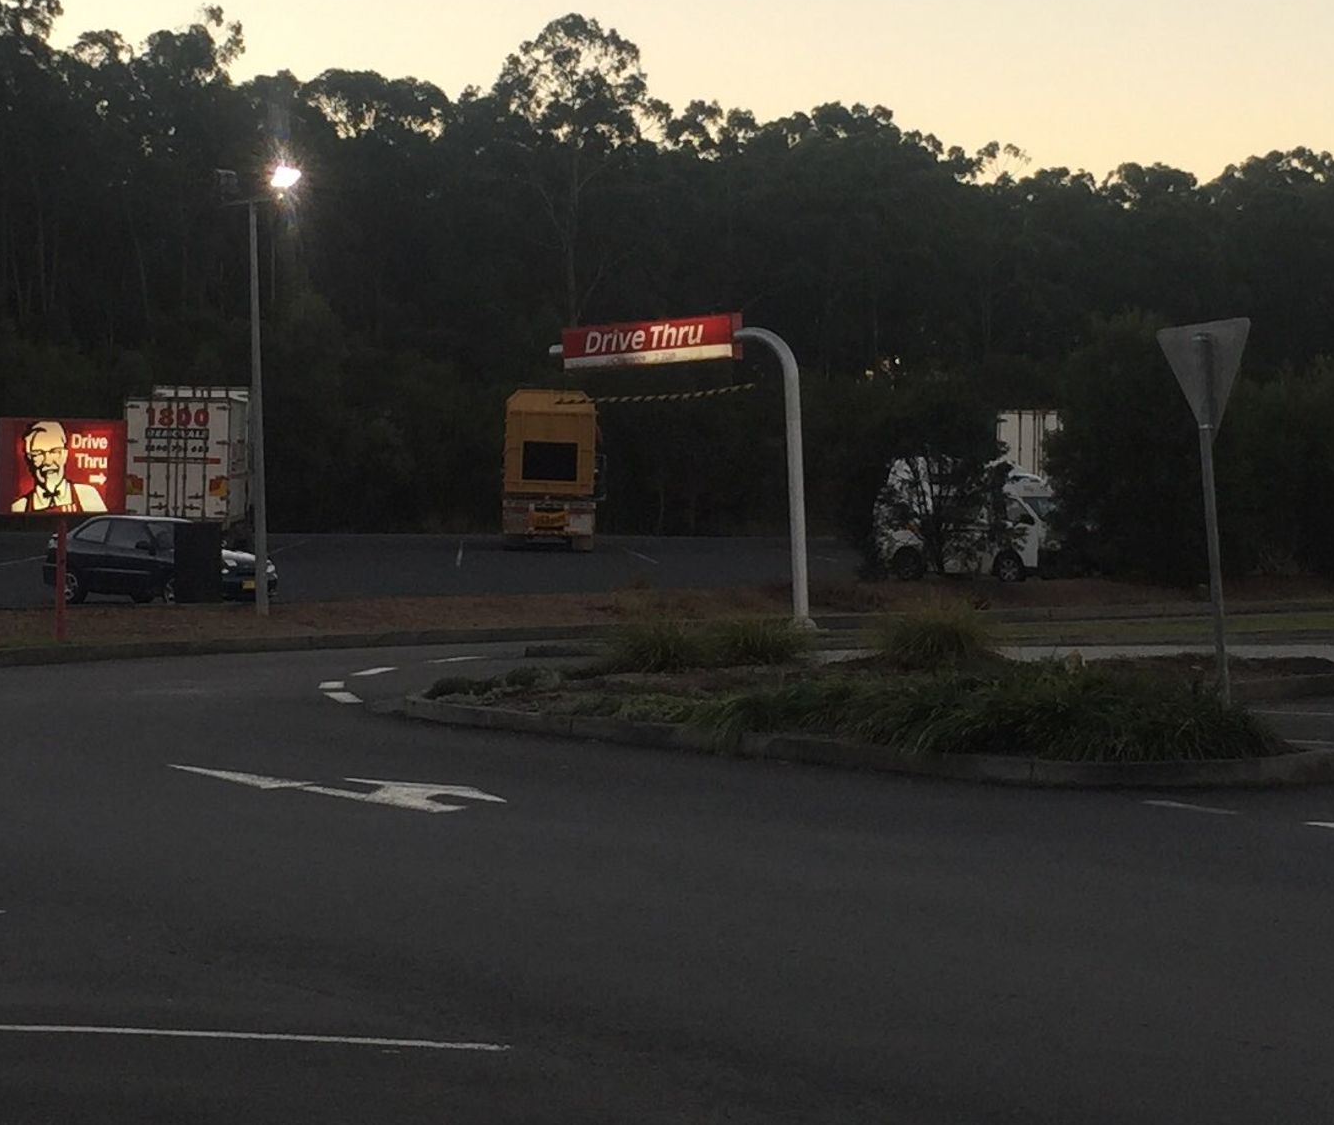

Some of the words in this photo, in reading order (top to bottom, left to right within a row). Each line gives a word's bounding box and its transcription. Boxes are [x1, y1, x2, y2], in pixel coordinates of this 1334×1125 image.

[585, 329, 646, 354] Drive
[649, 324, 704, 349] Thru
[146, 408, 209, 426] 1800
[71, 434, 108, 449] Drive
[75, 453, 108, 469] Thru
